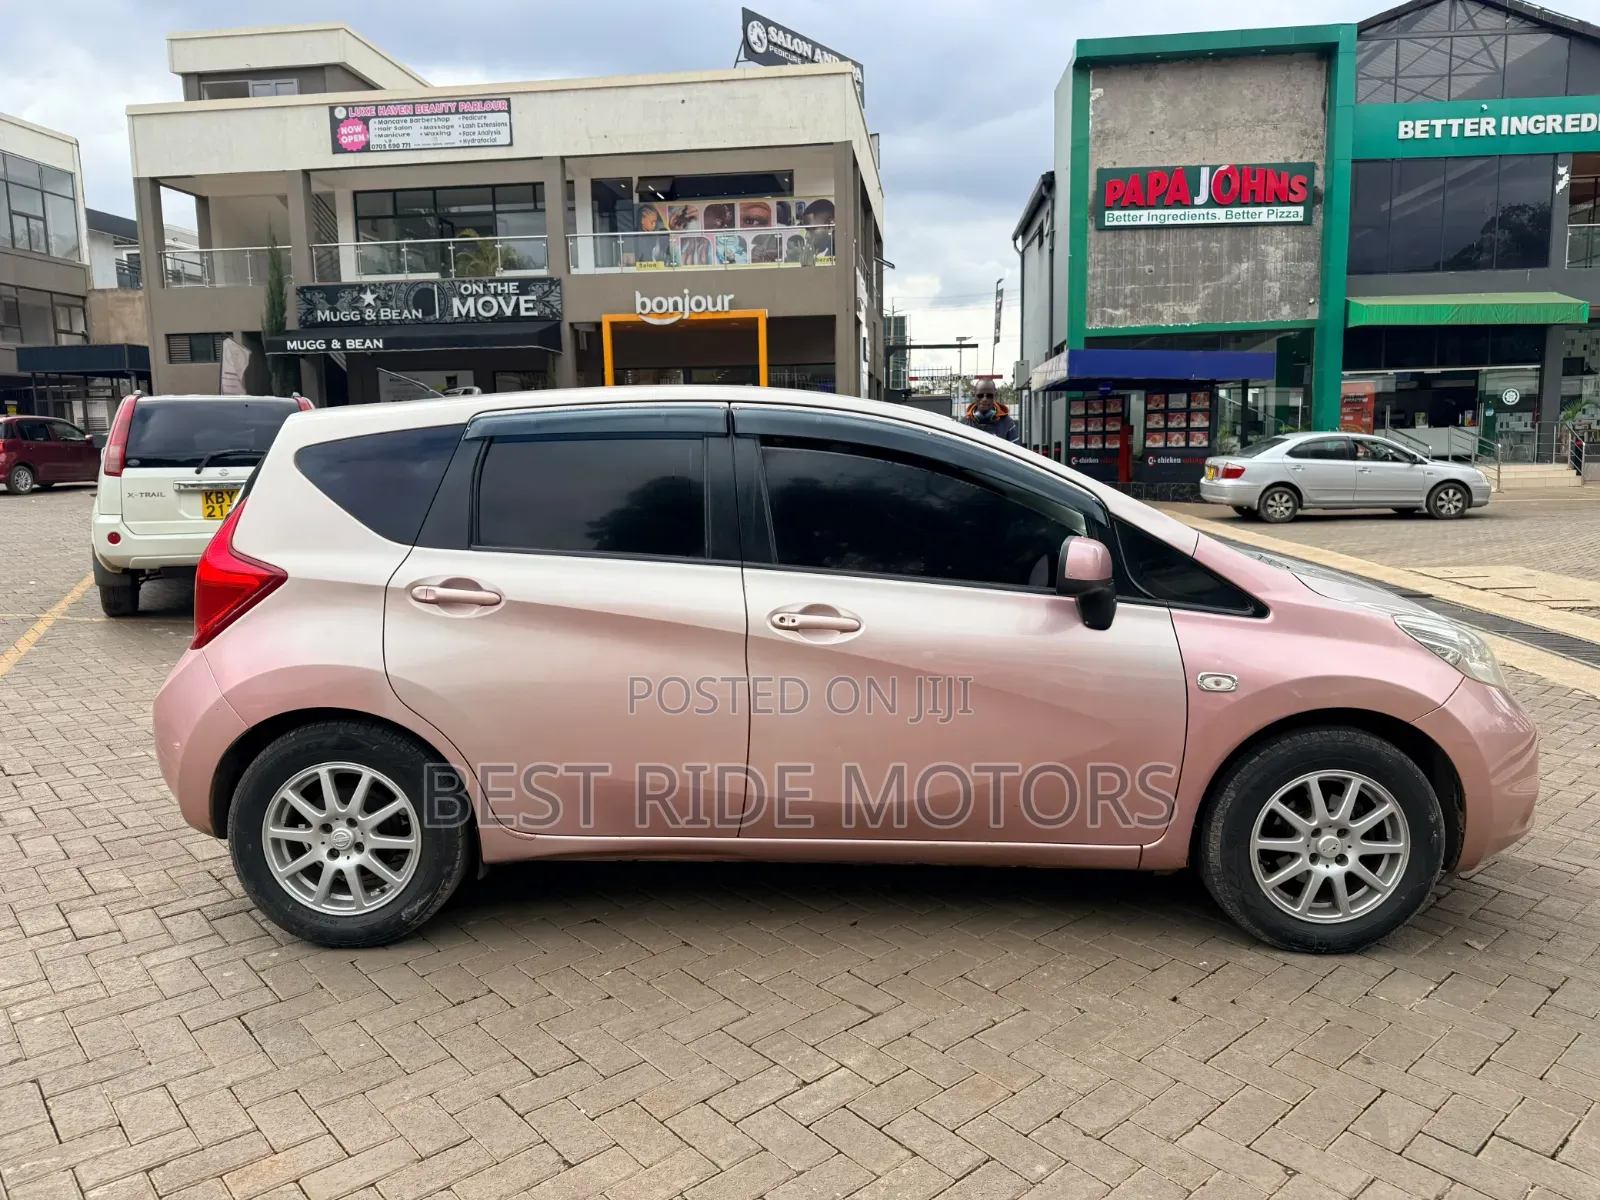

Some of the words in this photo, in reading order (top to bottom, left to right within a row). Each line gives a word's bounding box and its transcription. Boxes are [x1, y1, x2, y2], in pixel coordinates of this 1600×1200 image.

[767, 26, 812, 59] SALON
[769, 45, 802, 64] PEDICURE
[348, 106, 376, 117] LUXE
[378, 104, 413, 116] HAVEN
[415, 102, 457, 114] BEAUTY
[458, 100, 508, 112] PARLOUR
[409, 116, 450, 124] Barbershop
[1397, 117, 1497, 140] BETTER
[340, 125, 362, 135] NOW
[341, 134, 365, 144] OPEN
[1105, 167, 1192, 207] PAPA
[1193, 164, 1308, 206] JOHNS
[1106, 212, 1144, 223] Better
[1147, 210, 1220, 225] Ingredients.
[1225, 209, 1263, 220] Better
[1266, 208, 1303, 220] Pizza.
[460, 283, 484, 295] ON
[487, 282, 520, 294] THE
[452, 295, 539, 318] MOVE
[635, 288, 735, 320] bonjour
[317, 309, 361, 322] MUGG
[364, 308, 377, 320] &
[380, 307, 423, 320] BEAN
[286, 340, 326, 351] MUGG
[331, 339, 341, 349] &
[346, 339, 384, 349] BEAN
[204, 490, 235, 505] KBY
